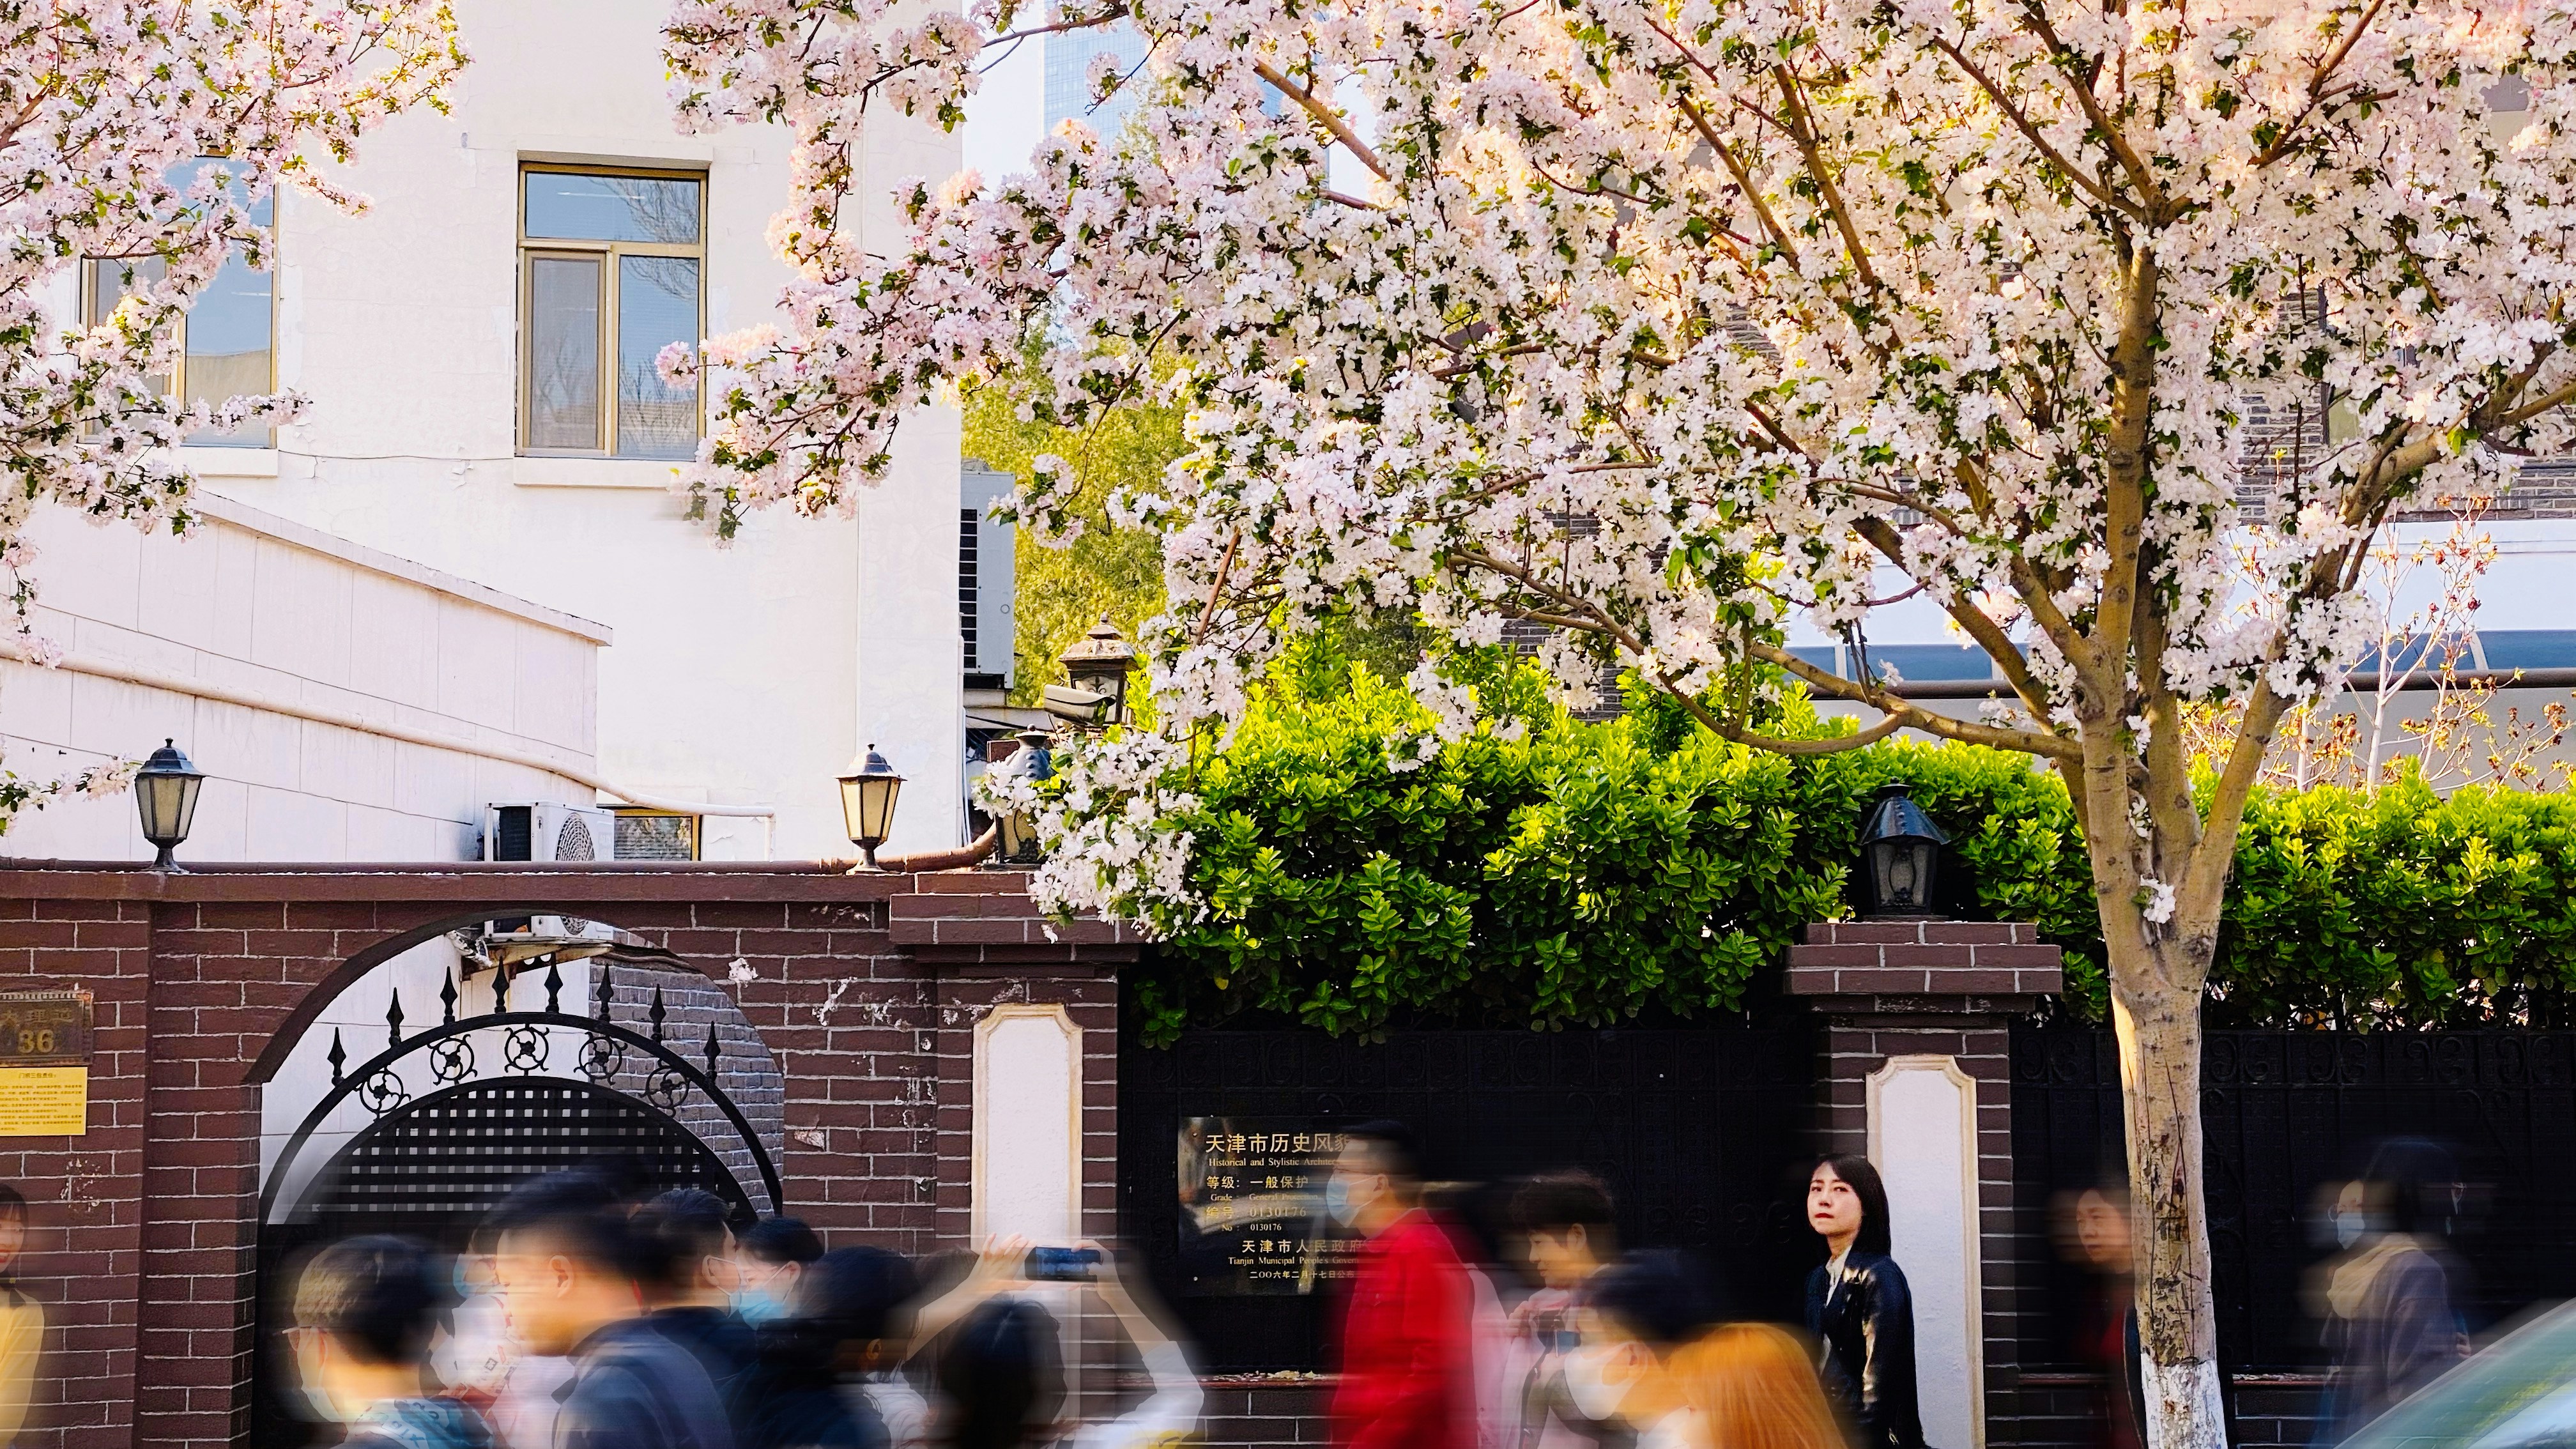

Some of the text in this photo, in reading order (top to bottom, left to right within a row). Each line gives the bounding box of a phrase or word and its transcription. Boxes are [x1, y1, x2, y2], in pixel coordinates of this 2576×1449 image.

[18, 1030, 54, 1054] 36
[1209, 1157, 1246, 1167] Historical
[1250, 1158, 1264, 1166] and
[1268, 1157, 1300, 1168] Stylistic
[1250, 1176, 1308, 1189] 一般保护
[1249, 1207, 1307, 1218] 0130176
[1250, 1223, 1282, 1232] 0130176
[1241, 1238, 1364, 1254] 天津市人民政府
[1228, 1257, 1254, 1266] Tianjin
[1259, 1257, 1295, 1266] Municipal
[1299, 1257, 1329, 1266] People's
